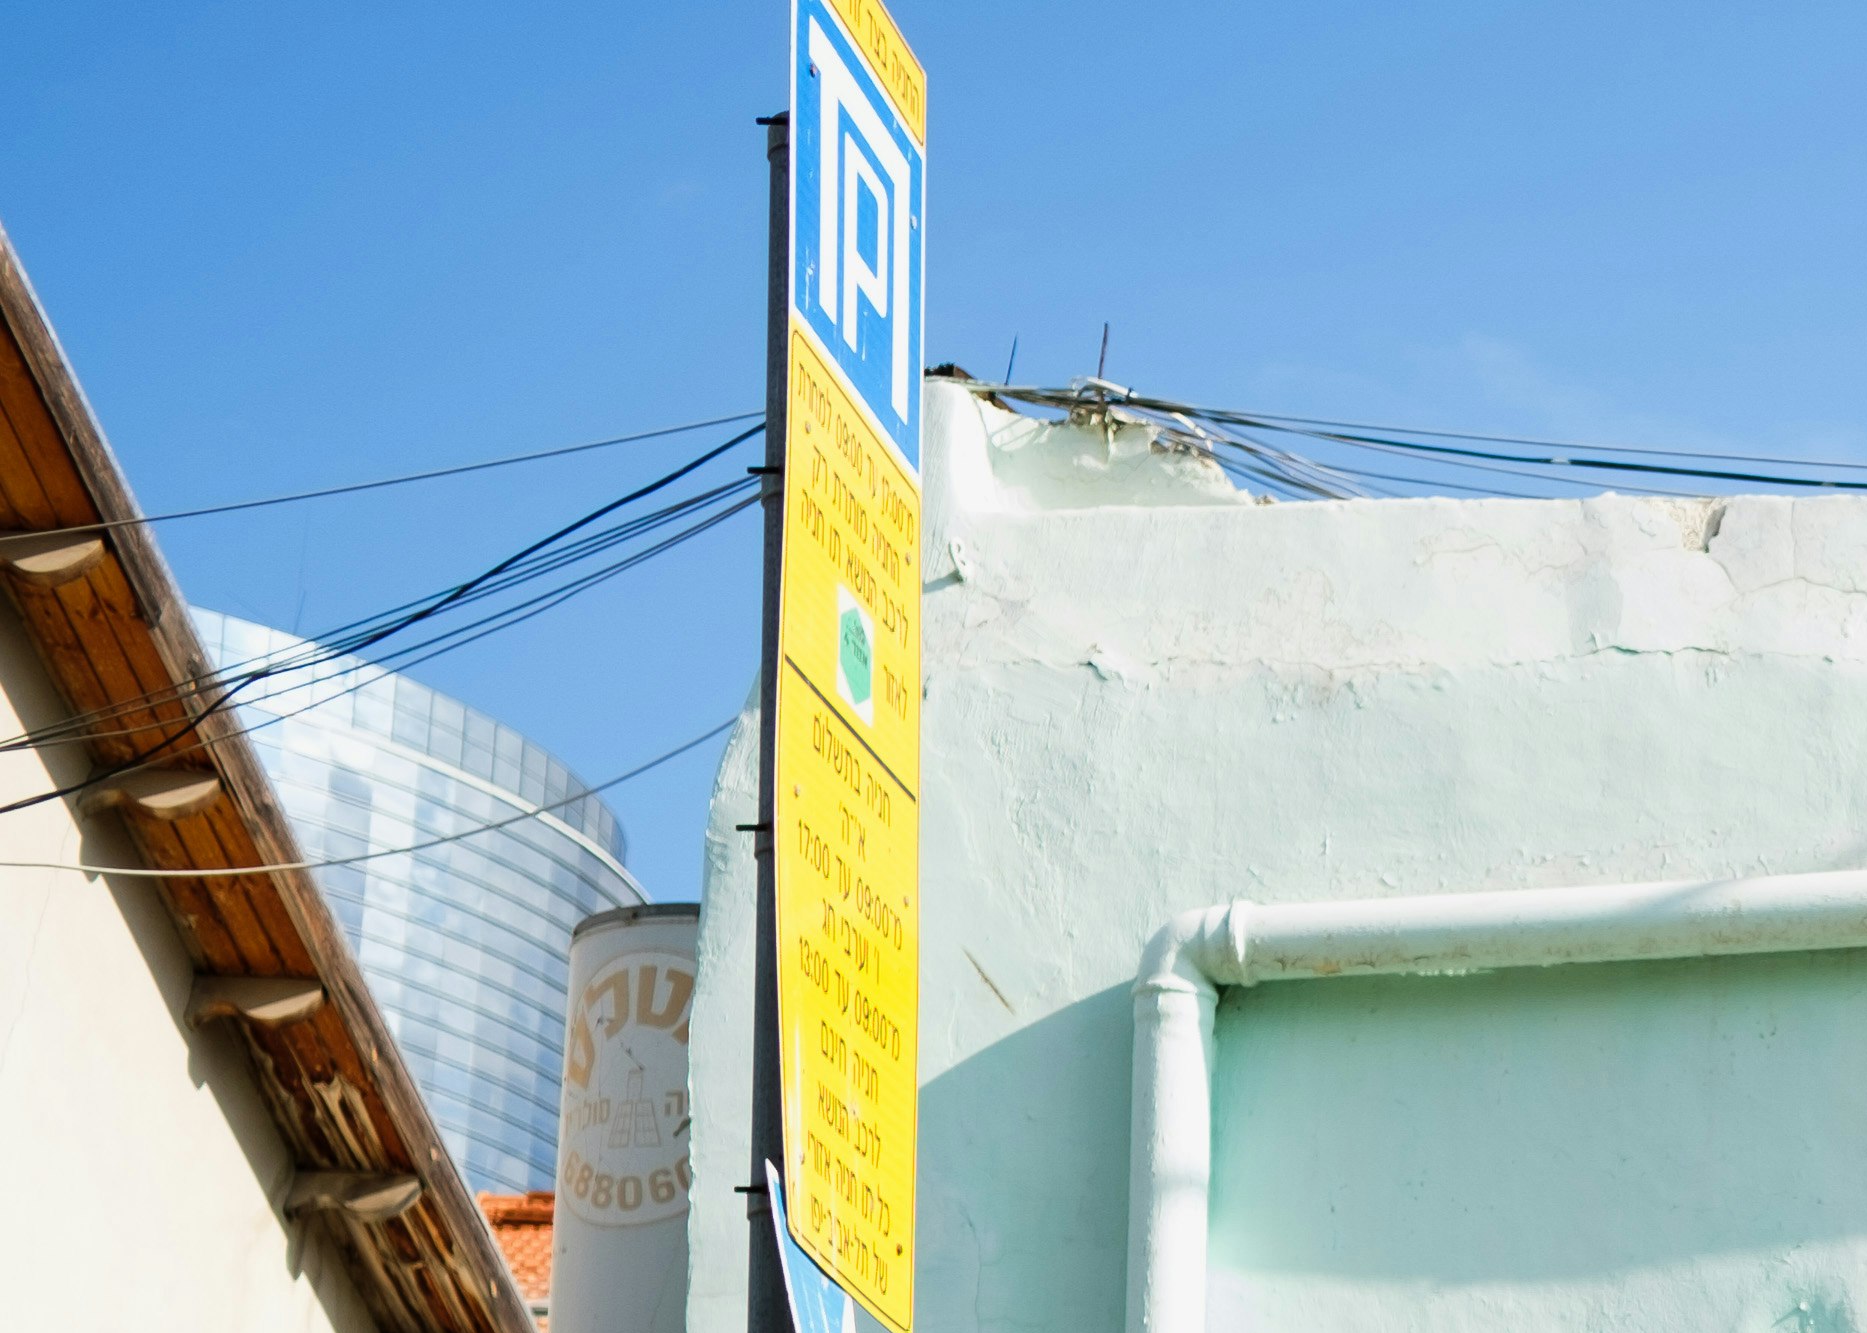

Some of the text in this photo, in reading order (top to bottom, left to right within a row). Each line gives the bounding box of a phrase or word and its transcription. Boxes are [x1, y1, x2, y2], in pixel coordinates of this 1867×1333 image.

[813, 711, 891, 827] חניה בתשלום
[798, 819, 830, 879] 17:00
[836, 854, 851, 900] עד
[822, 898, 836, 941] חג
[799, 935, 829, 995] 13:00
[835, 968, 849, 1014] עד
[821, 1019, 878, 1103] חניה חינם
[836, 1158, 858, 1209] חניה
[873, 1242, 888, 1295] של
